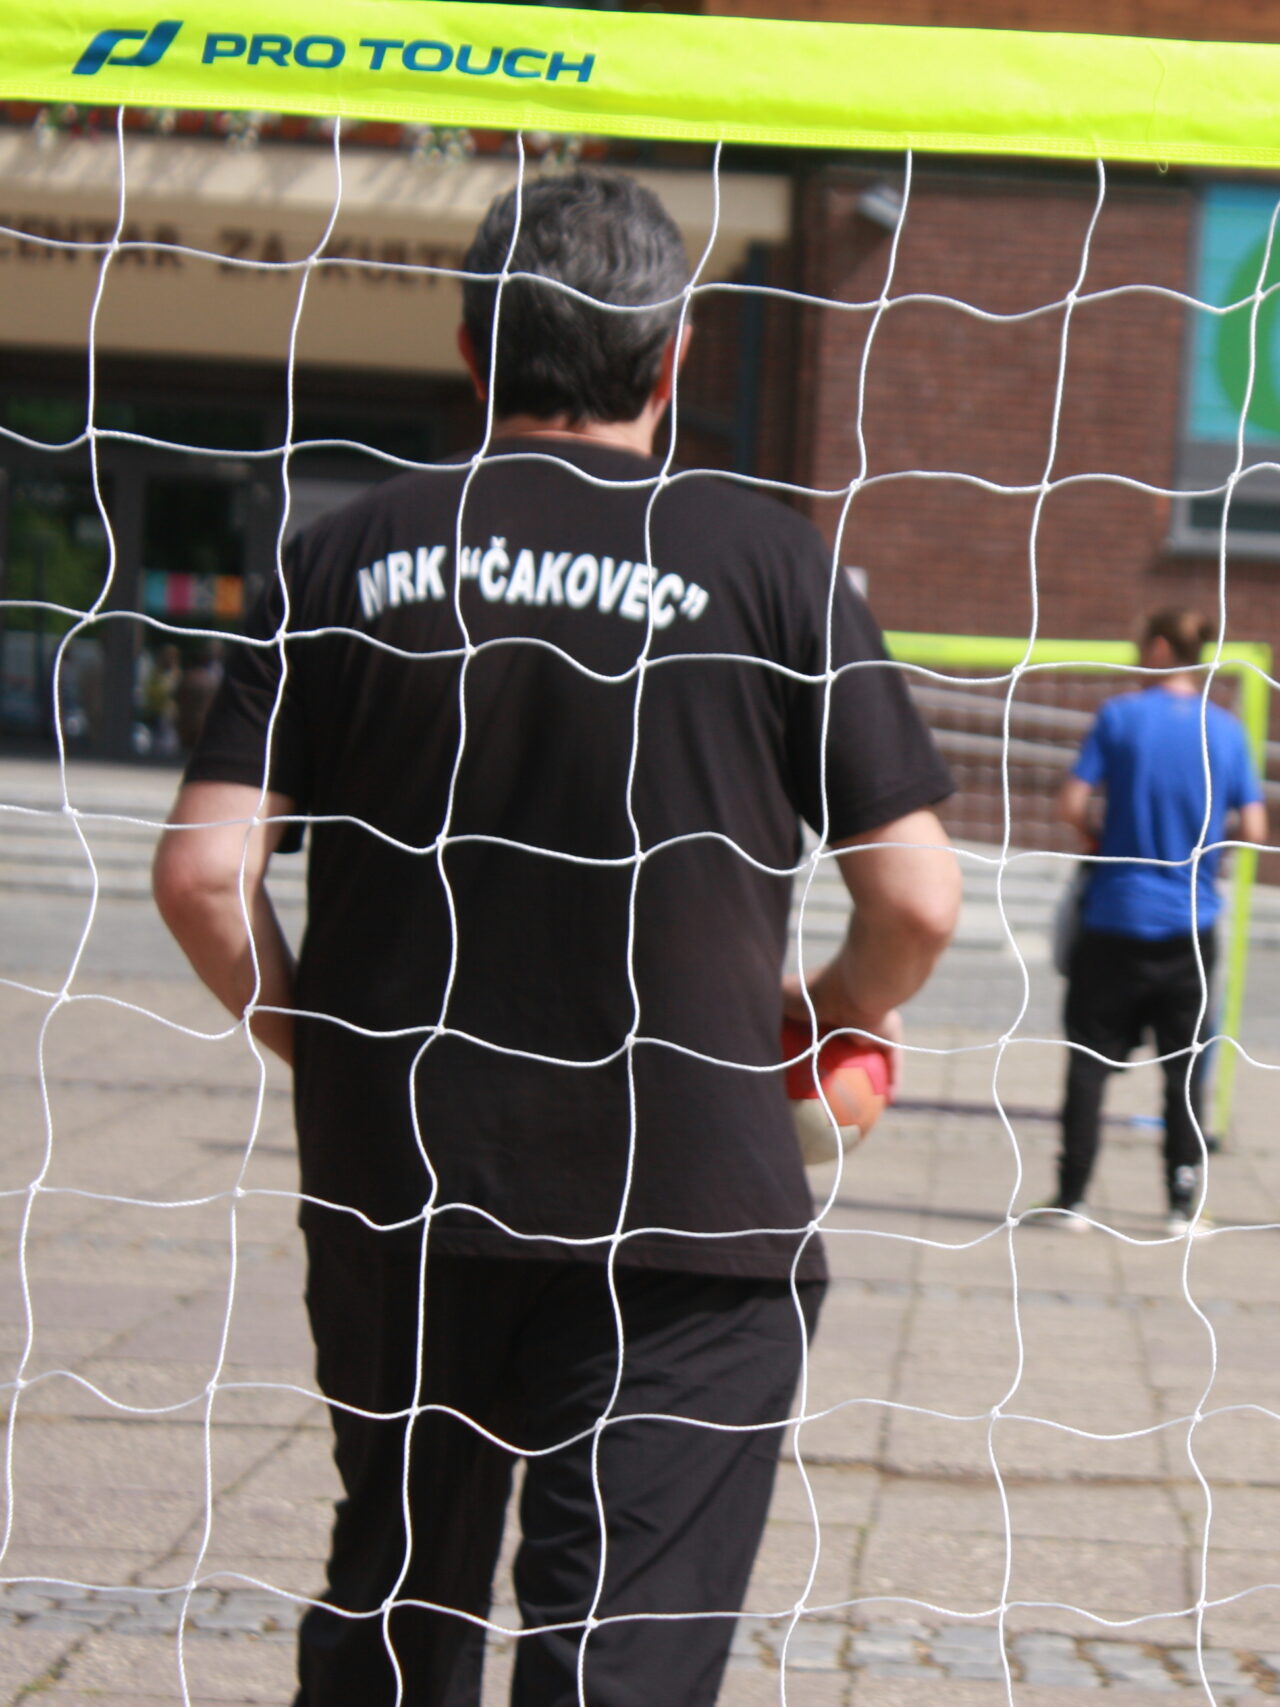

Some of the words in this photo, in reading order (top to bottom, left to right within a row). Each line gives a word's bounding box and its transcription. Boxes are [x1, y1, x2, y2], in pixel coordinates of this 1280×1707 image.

[201, 32, 345, 69] PRO
[358, 37, 596, 82] TOUCH
[0, 214, 183, 268] ENTAR
[357, 545, 447, 620] NRK
